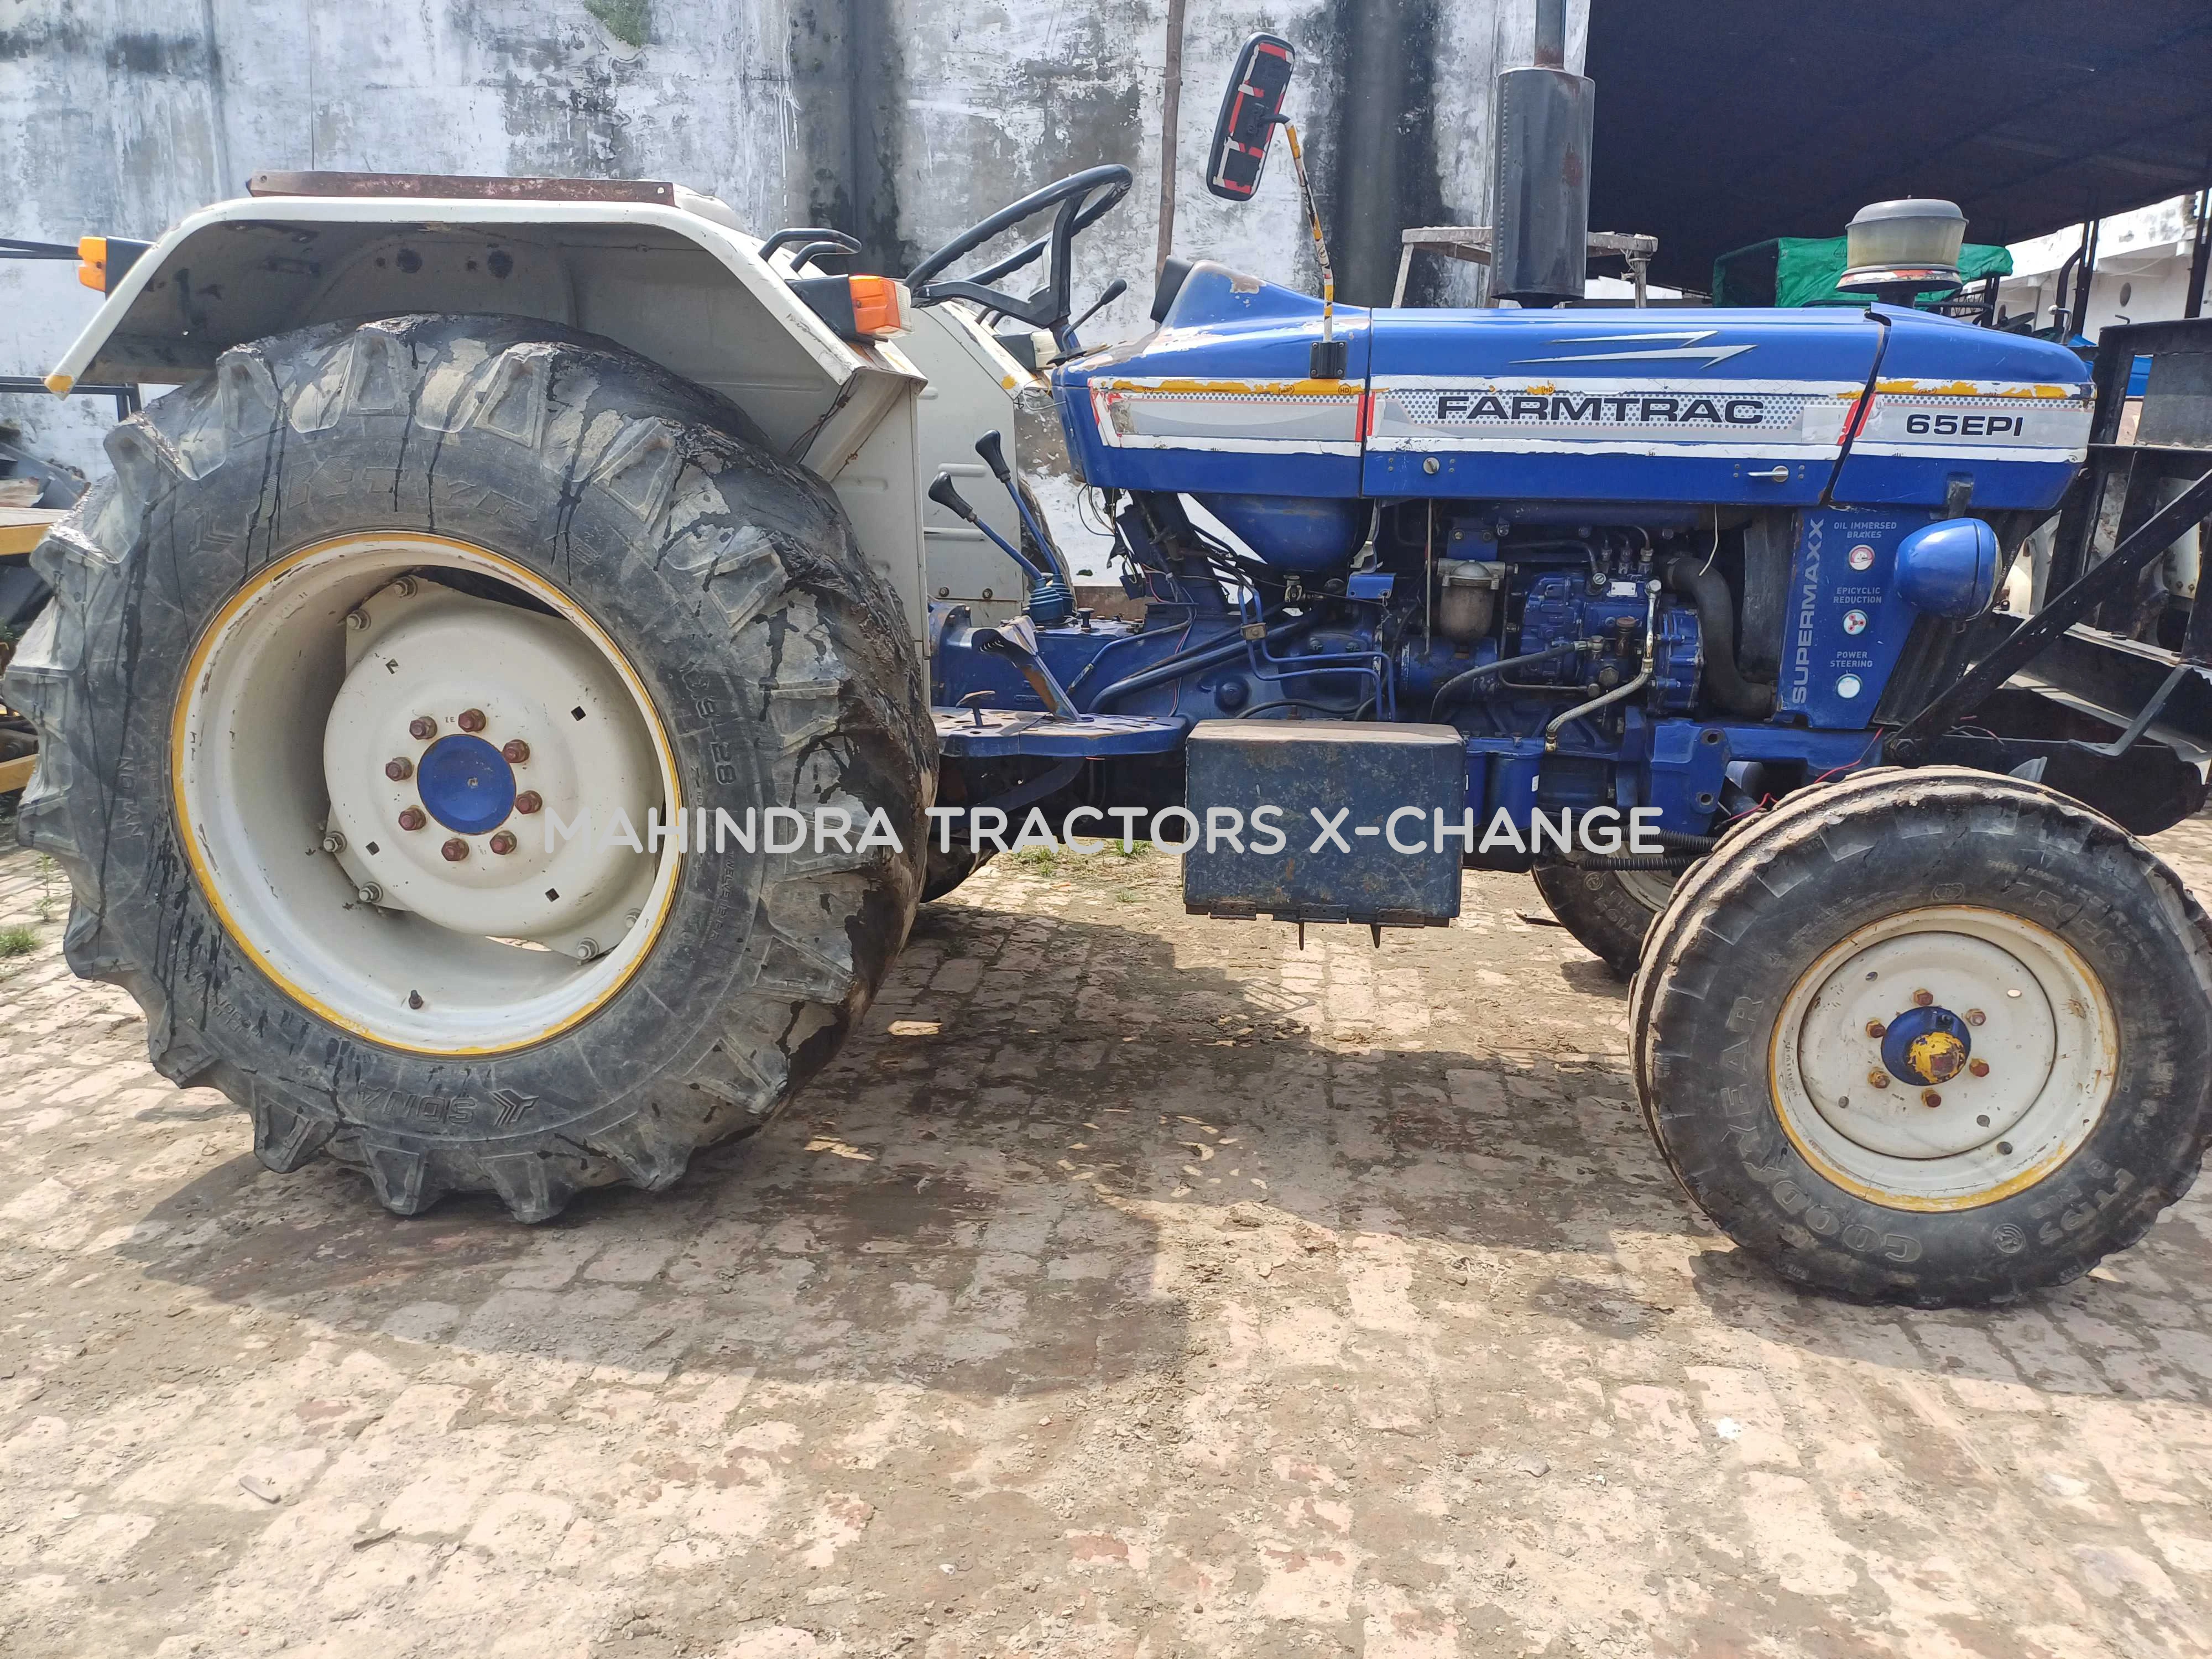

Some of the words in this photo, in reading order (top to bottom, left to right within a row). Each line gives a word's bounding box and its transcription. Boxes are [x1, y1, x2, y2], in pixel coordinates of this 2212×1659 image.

[1437, 395, 1764, 424] FARMTRAC
[1906, 414, 2024, 437] 65EPI
[1833, 596, 1882, 604] REDUCTION
[1836, 587, 1881, 595] EPICYCLIC
[1793, 519, 1824, 704] SUPERMAXX
[355, 1082, 479, 1124] SONA
[1771, 1180, 1921, 1262] GOOD
